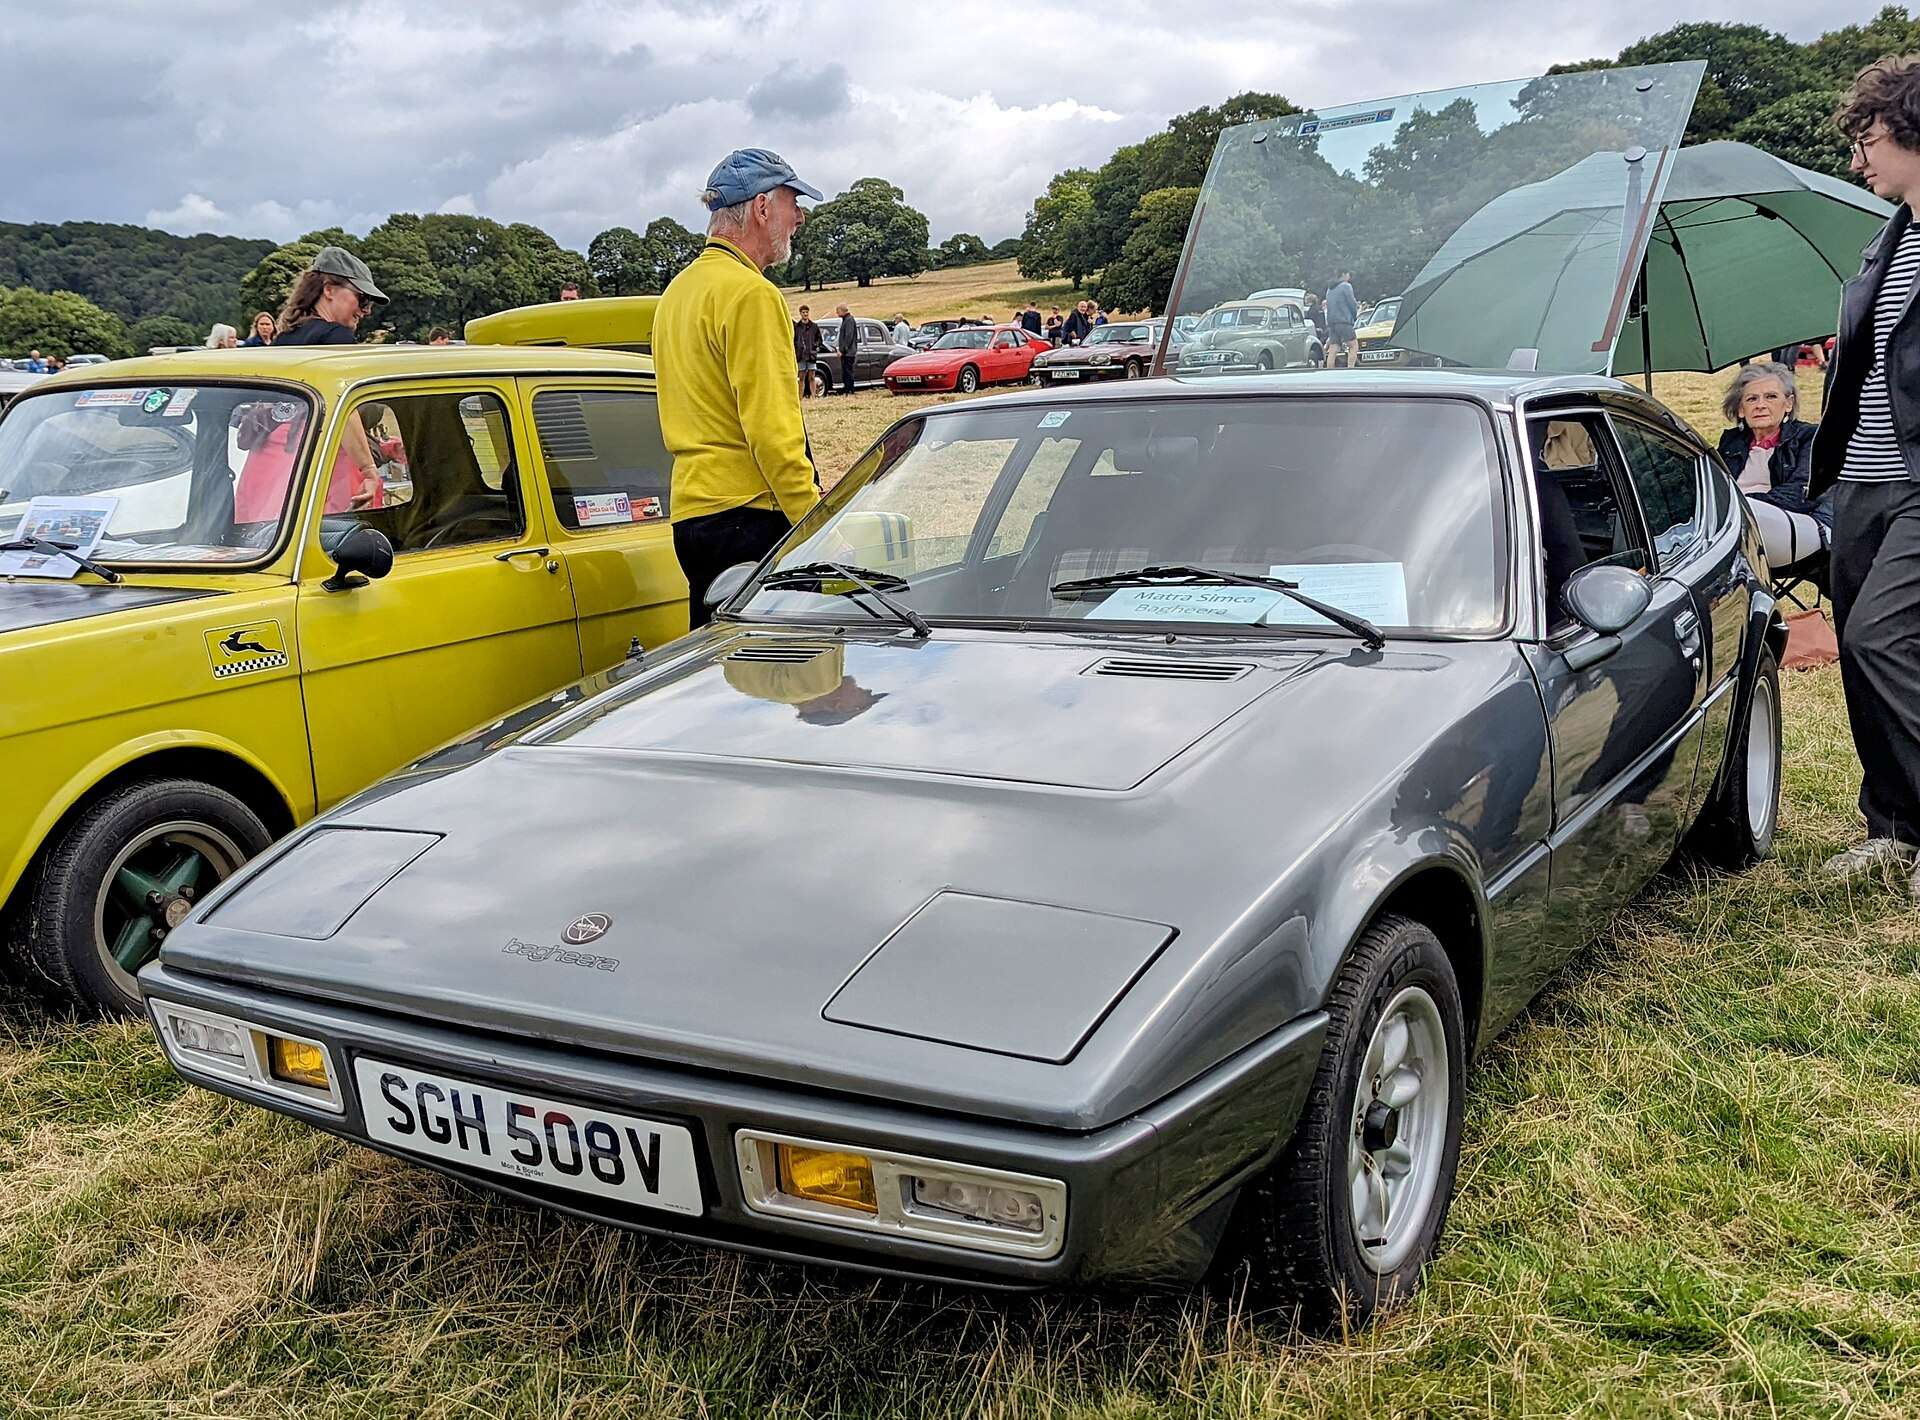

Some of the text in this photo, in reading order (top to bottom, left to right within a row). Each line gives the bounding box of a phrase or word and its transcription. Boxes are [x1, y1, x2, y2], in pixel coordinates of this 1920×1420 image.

[1133, 591, 1257, 604] Matra Simca
[1133, 603, 1230, 615] Bagheera
[501, 937, 621, 972] bagheera
[379, 1072, 661, 1195] SGH 508V
[500, 1160, 515, 1170] Mon
[522, 1166, 545, 1177] Border
